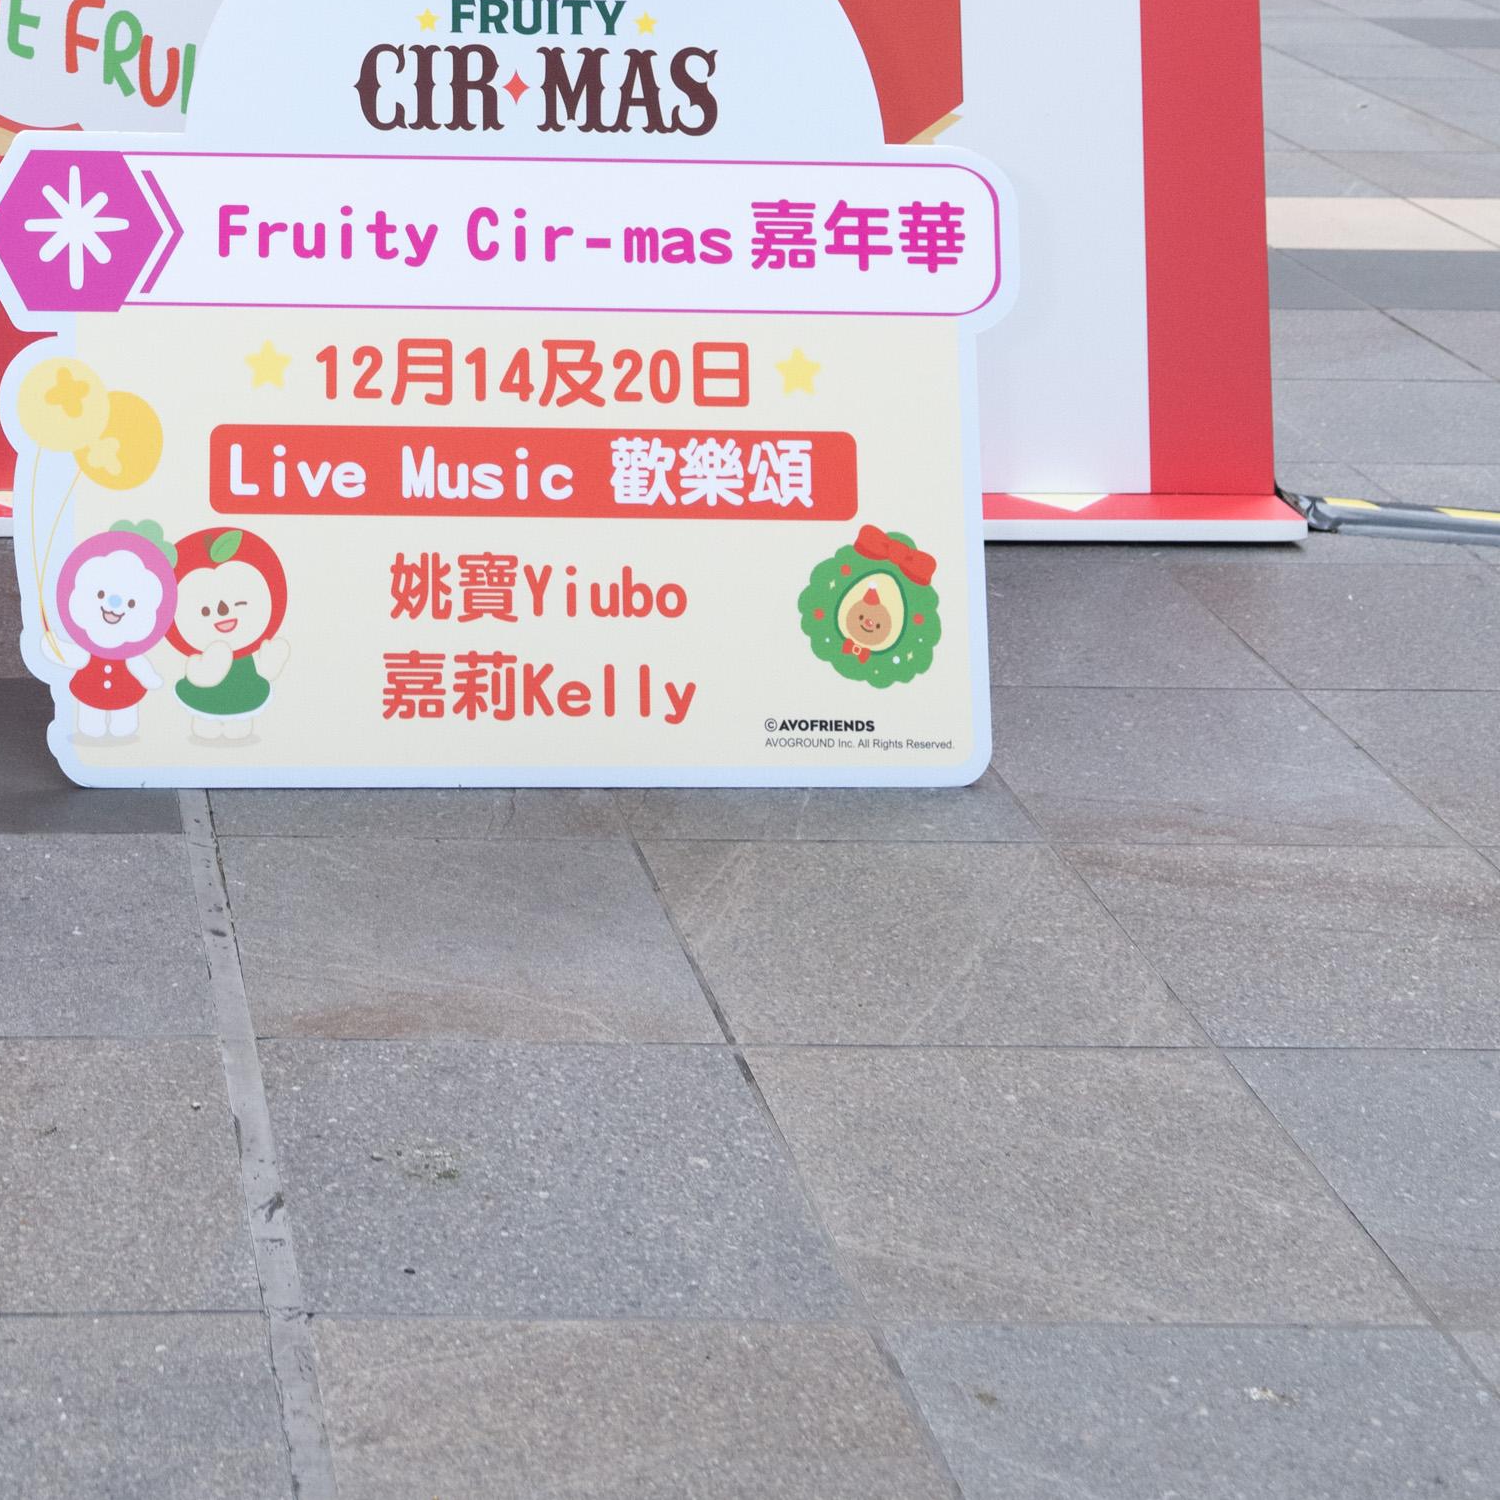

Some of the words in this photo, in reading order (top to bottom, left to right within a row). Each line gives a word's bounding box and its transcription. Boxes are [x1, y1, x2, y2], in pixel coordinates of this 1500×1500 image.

[216, 205, 439, 267] Fruity
[465, 205, 733, 265] Cir-mas
[750, 200, 966, 274] 嘉年華
[314, 337, 751, 408] 12月14及20日
[228, 445, 366, 500] Live
[402, 447, 573, 502] Music
[609, 438, 815, 510] 歡樂頌
[388, 551, 687, 622] 姚寶Yiubo
[382, 651, 696, 725] 嘉莉Kelly
[765, 738, 835, 748] AVOGROUND
[838, 738, 855, 748] Inc.
[858, 738, 870, 749] All
[873, 738, 903, 750] Rights
[906, 739, 955, 750] Reserved.
